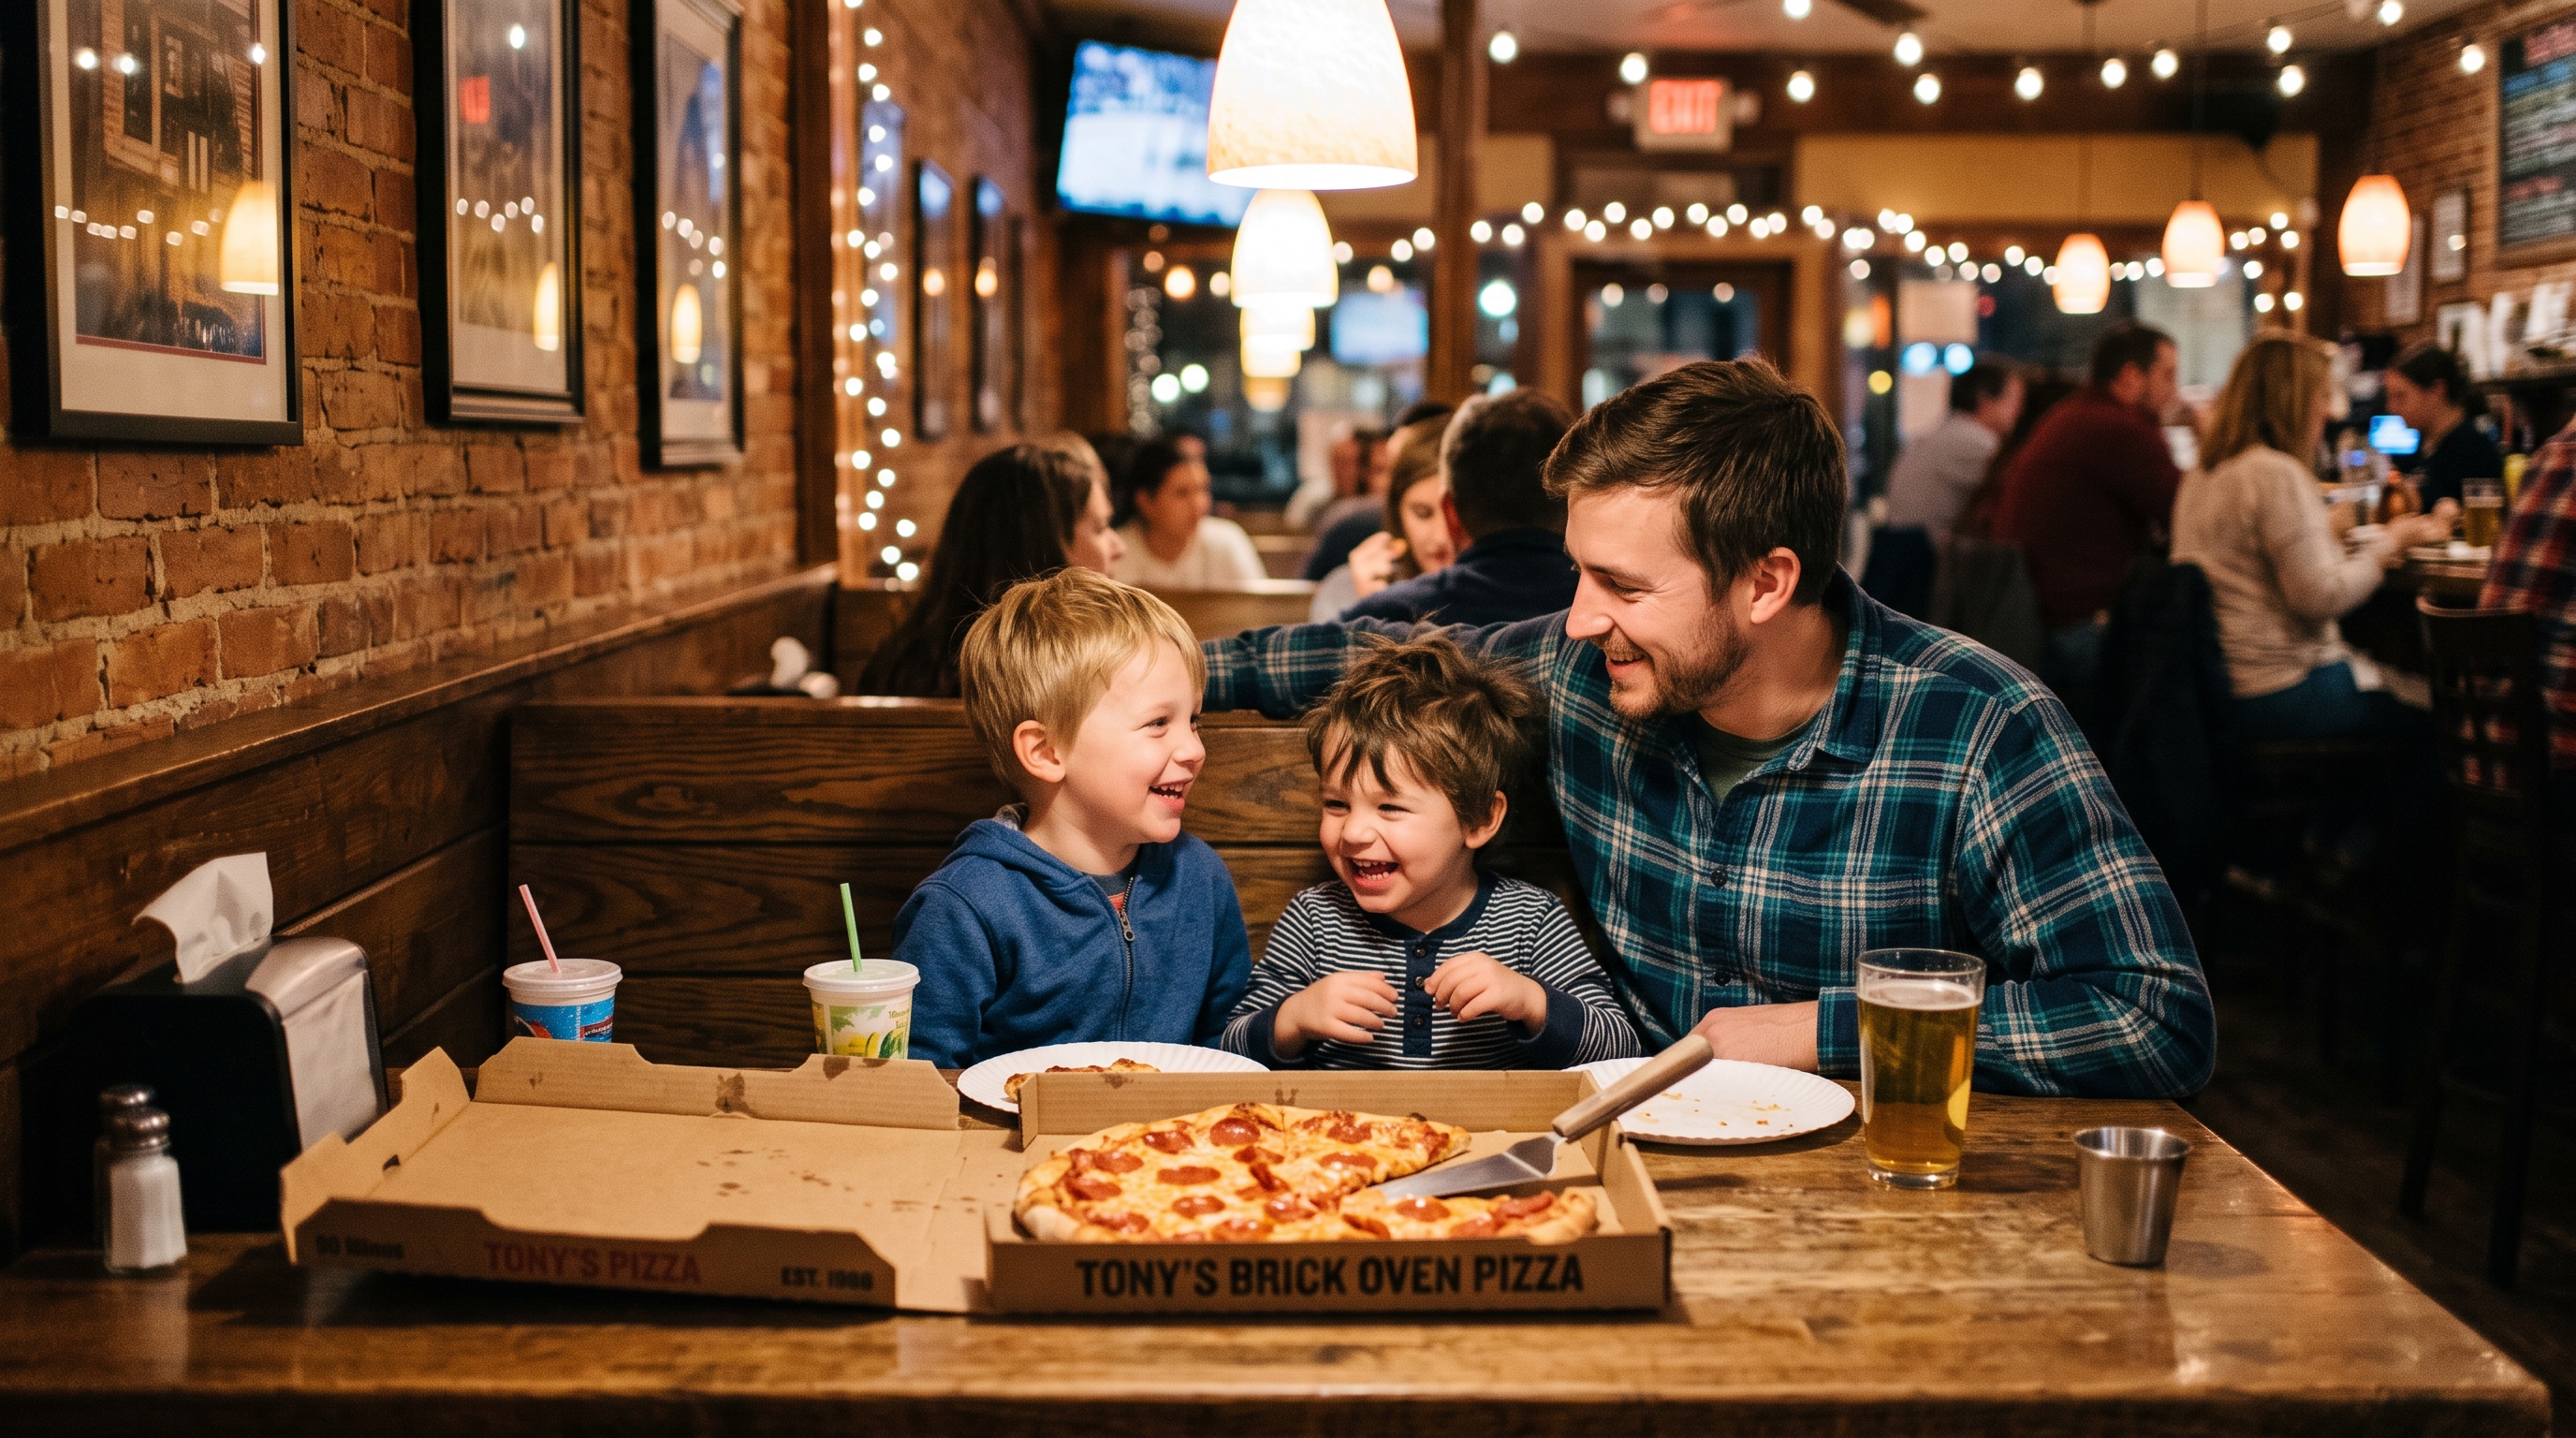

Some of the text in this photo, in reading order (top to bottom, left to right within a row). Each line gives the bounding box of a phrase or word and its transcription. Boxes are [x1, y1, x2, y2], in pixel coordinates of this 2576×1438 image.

[484, 1241, 700, 1283] TONY'S PIZZA
[1077, 1253, 1584, 1297] TONY'S BRICK OVEN PIZZA
